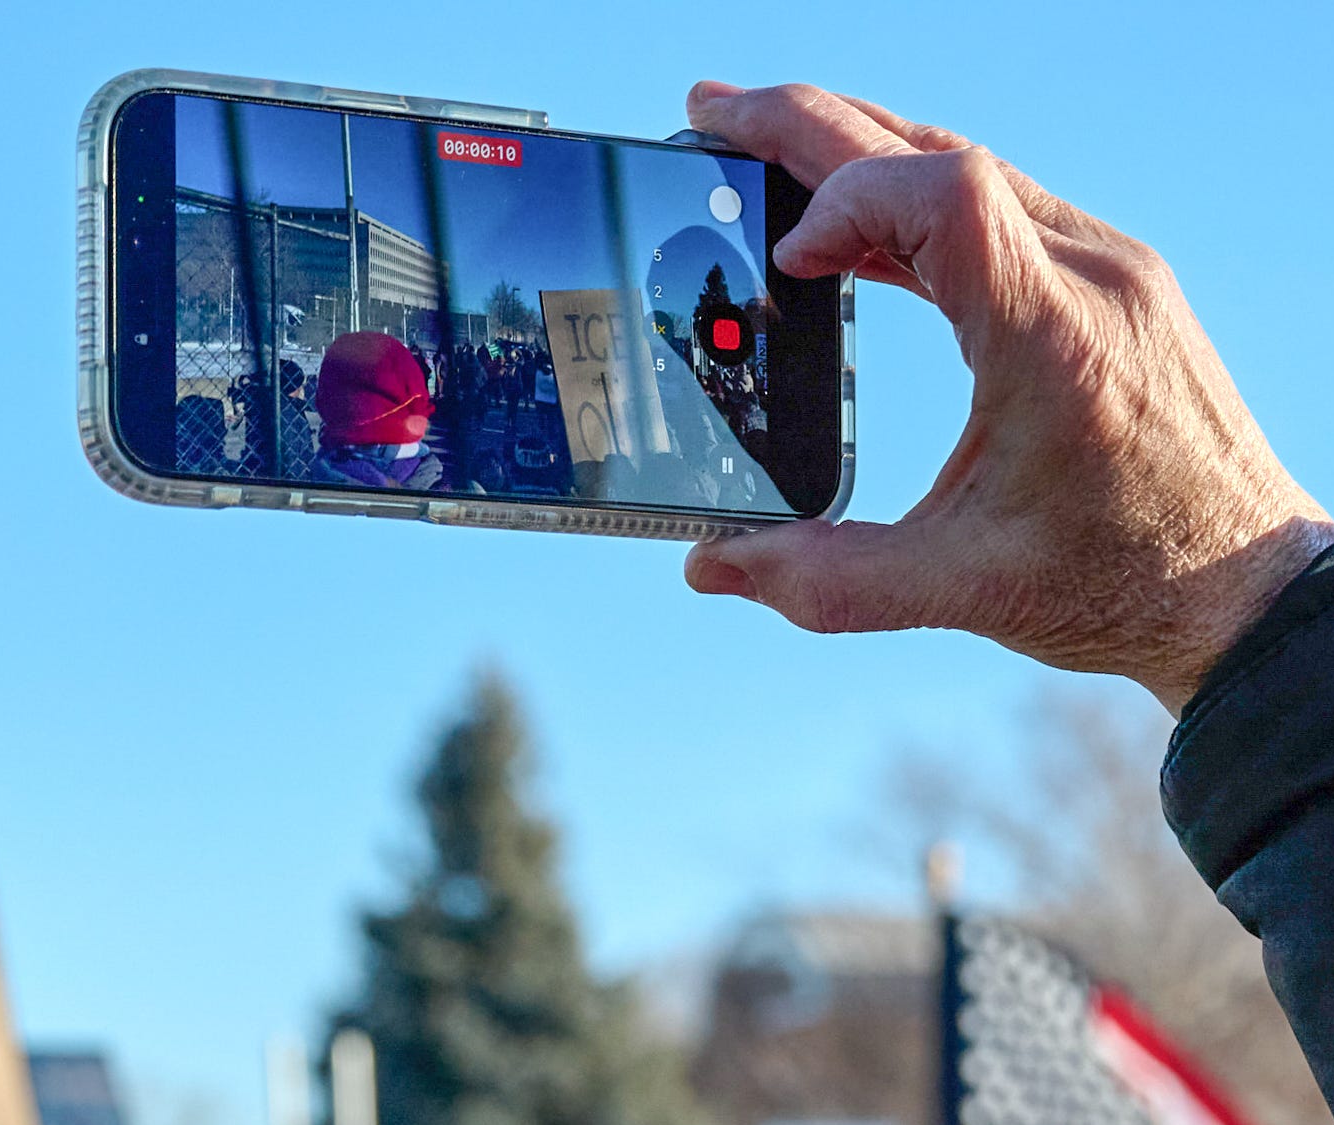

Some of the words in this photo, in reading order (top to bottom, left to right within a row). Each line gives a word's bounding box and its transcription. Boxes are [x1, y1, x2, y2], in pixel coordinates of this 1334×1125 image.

[444, 139, 516, 161] 00:00:10
[653, 248, 663, 261] 5
[654, 285, 663, 298] 2
[564, 313, 627, 363] ICE
[652, 358, 666, 371] .5
